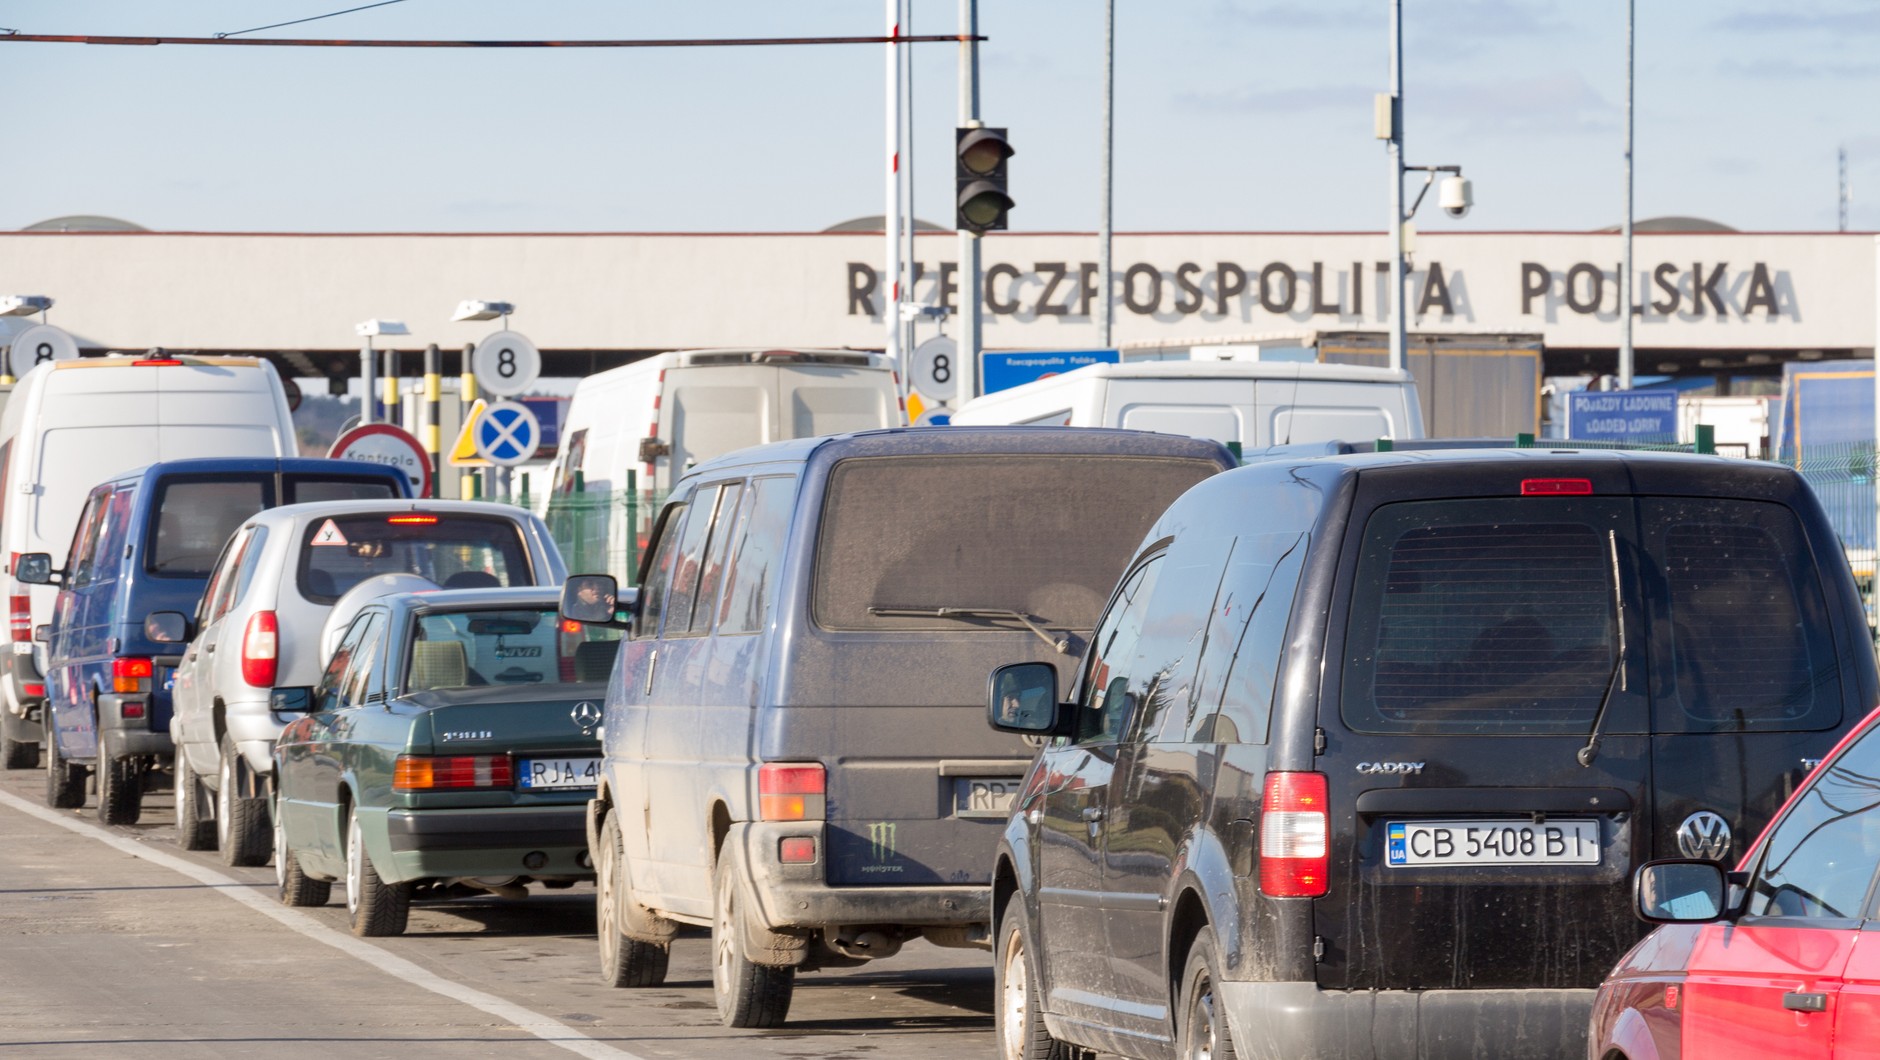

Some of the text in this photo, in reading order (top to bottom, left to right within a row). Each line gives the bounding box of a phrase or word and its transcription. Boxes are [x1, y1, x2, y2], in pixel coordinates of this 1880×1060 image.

[848, 262, 1453, 314] RECZPOSPOLIA
[497, 348, 516, 378] 8
[932, 354, 950, 384] 8
[1576, 397, 1620, 411] POJAZDY
[1586, 417, 1661, 433] LOADED LORRY
[347, 450, 415, 466] Kontrola
[533, 761, 601, 784] RJA 4
[1356, 762, 1425, 775] CADDY
[1410, 829, 1455, 858] CB
[1466, 827, 1535, 857] 5408
[1391, 850, 1405, 860] UA
